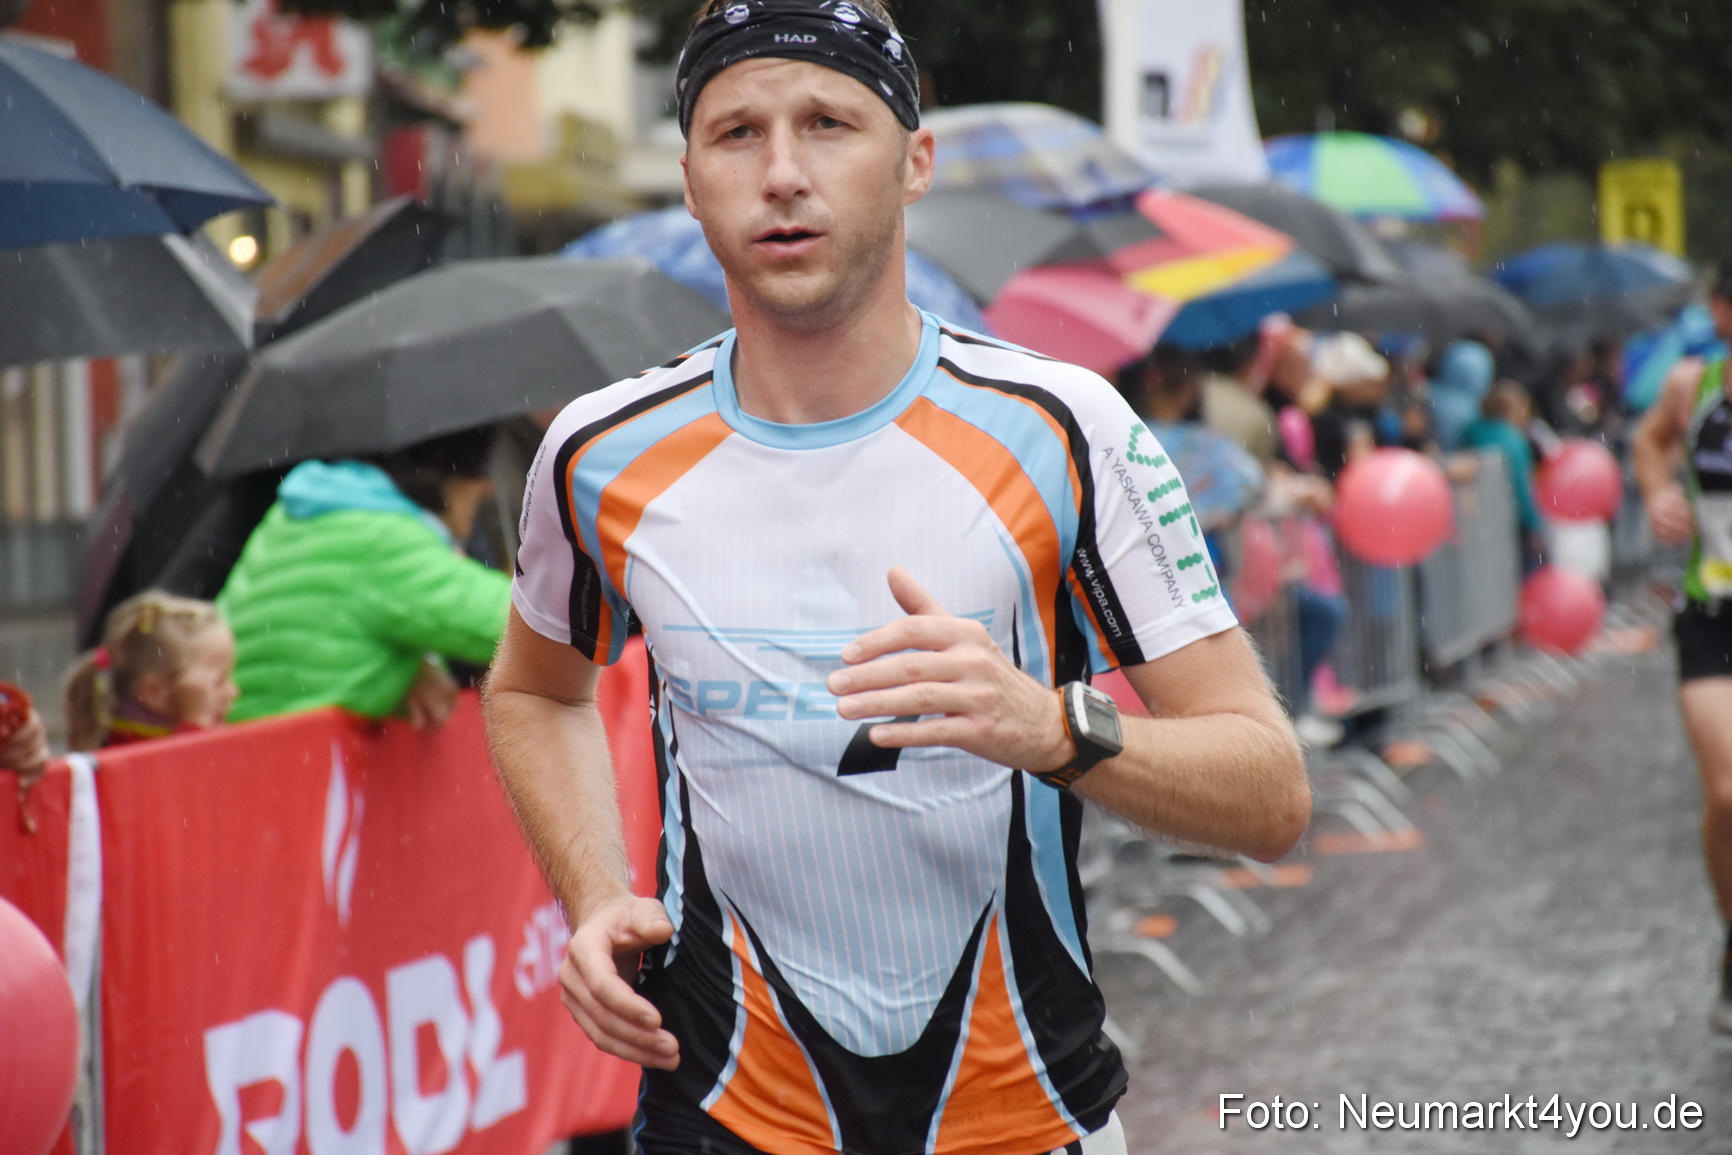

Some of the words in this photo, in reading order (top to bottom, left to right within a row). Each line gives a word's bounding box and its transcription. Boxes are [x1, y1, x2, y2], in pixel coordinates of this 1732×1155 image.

[774, 33, 818, 43] HAD
[1102, 447, 1114, 460] A
[1110, 457, 1154, 534] YASKAWA
[1147, 533, 1188, 609] COMPANY
[1077, 547, 1122, 637] www.vipa.com
